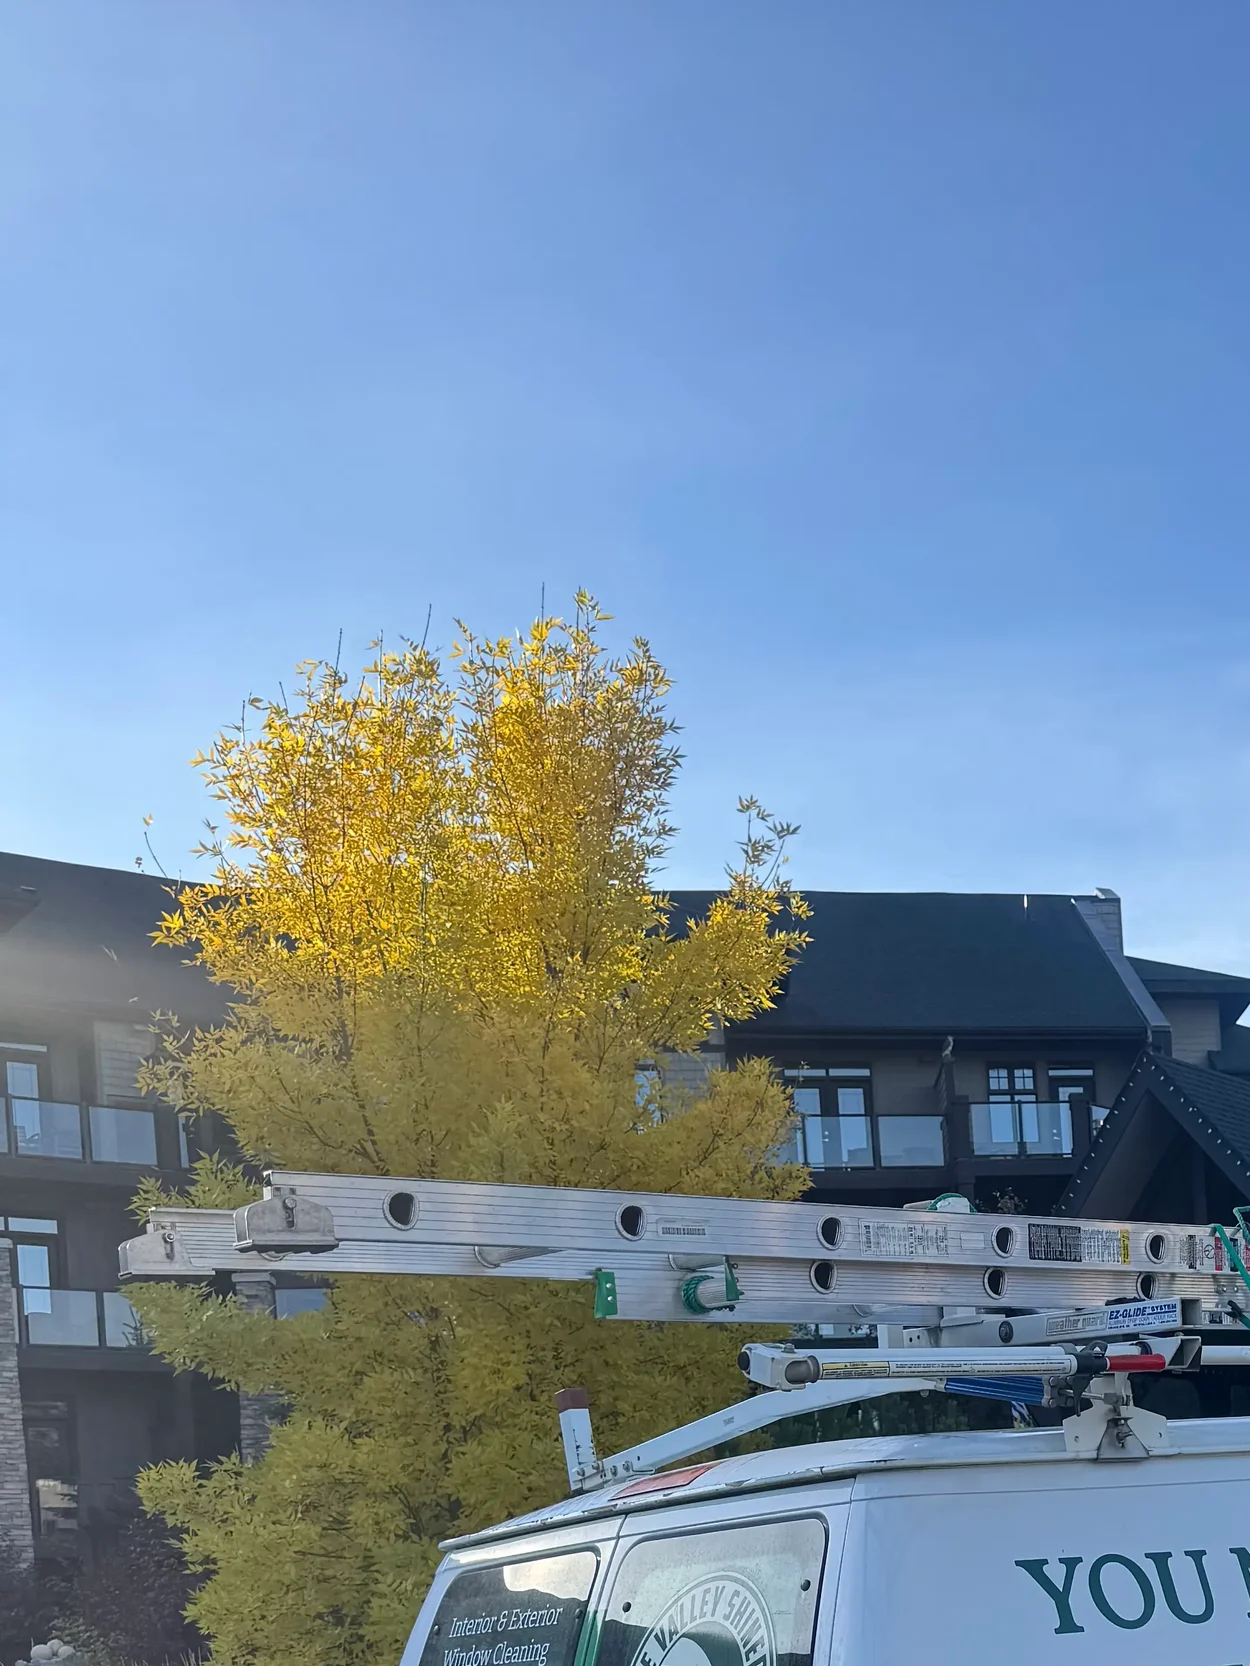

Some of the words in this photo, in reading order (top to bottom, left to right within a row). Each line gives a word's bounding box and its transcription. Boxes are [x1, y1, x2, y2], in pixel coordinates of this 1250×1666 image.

[1014, 1549, 1217, 1636] YOU
[449, 1612, 498, 1638] Interior
[497, 1610, 508, 1631] &
[508, 1604, 563, 1630] Exterior
[653, 1585, 726, 1652] VALLEY
[493, 1639, 550, 1666] Cleaning
